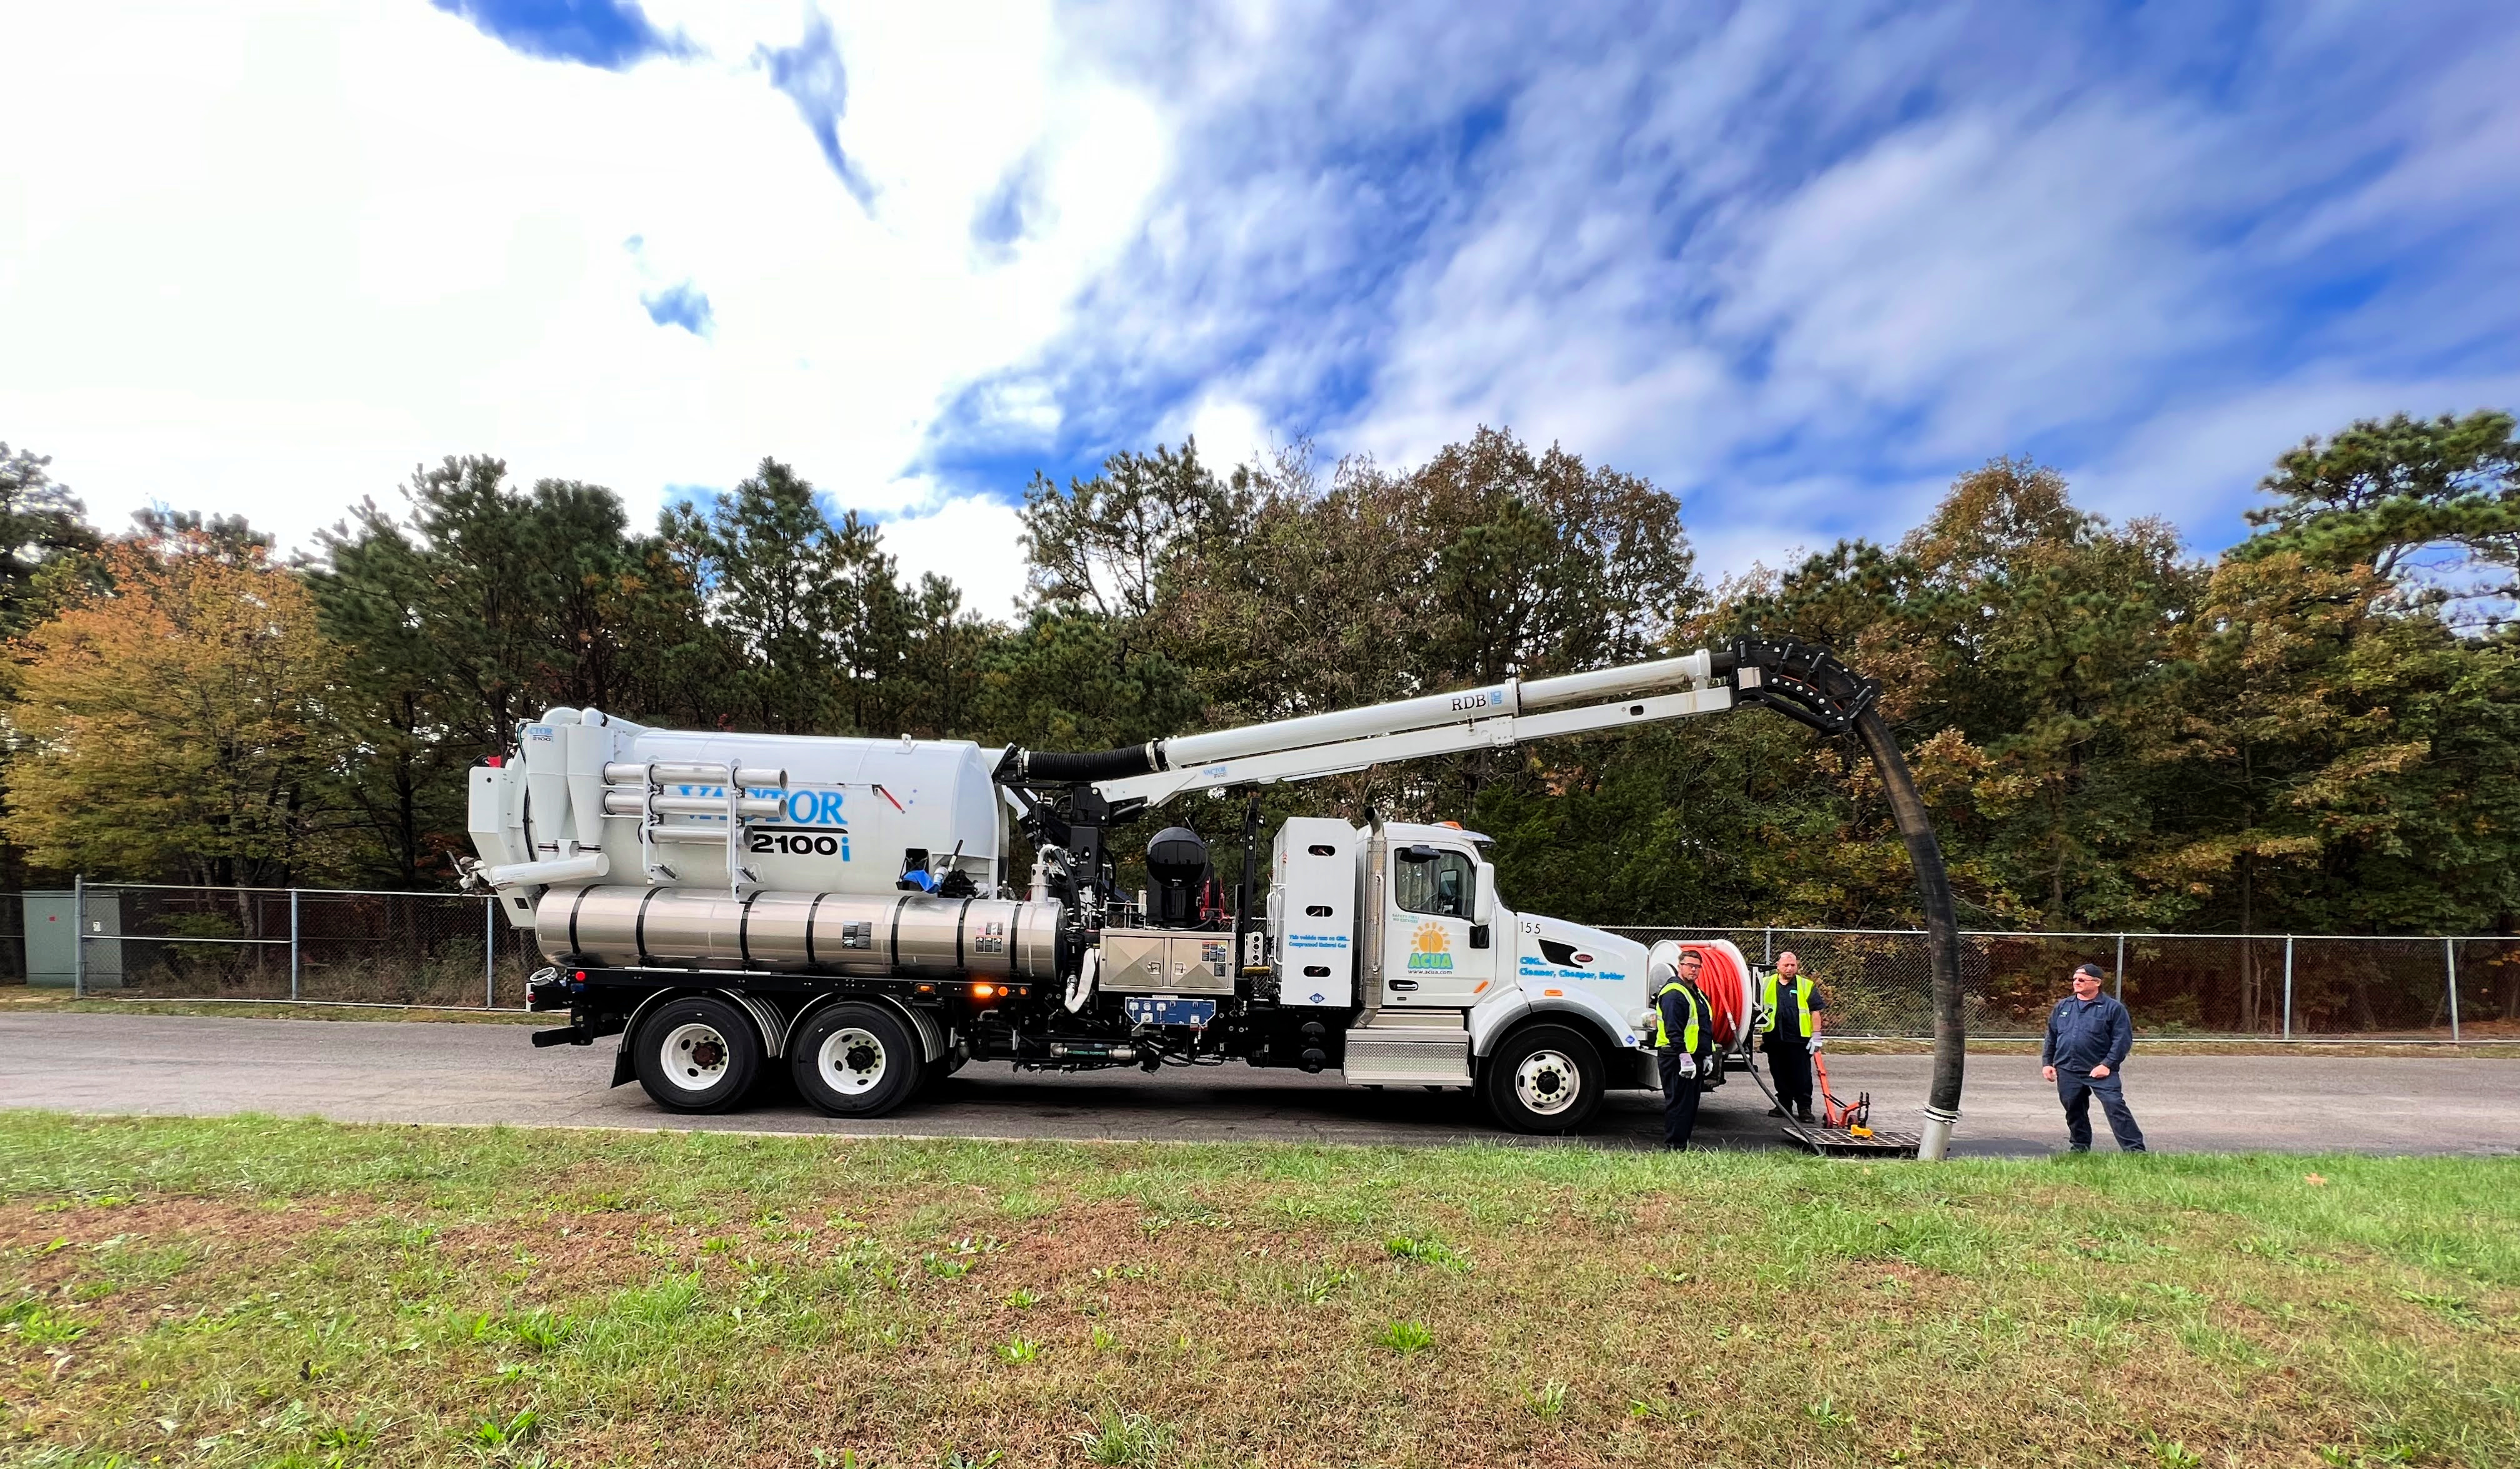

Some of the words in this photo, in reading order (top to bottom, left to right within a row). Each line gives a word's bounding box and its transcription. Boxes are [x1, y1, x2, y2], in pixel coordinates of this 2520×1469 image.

[1451, 694, 1486, 711] RDB
[1520, 922, 1541, 934] 155
[1408, 953, 1453, 969] ACUA
[1519, 968, 1556, 978] Cleaner,
[1559, 970, 1597, 980] Cheaper,
[1599, 972, 1625, 980] Better
